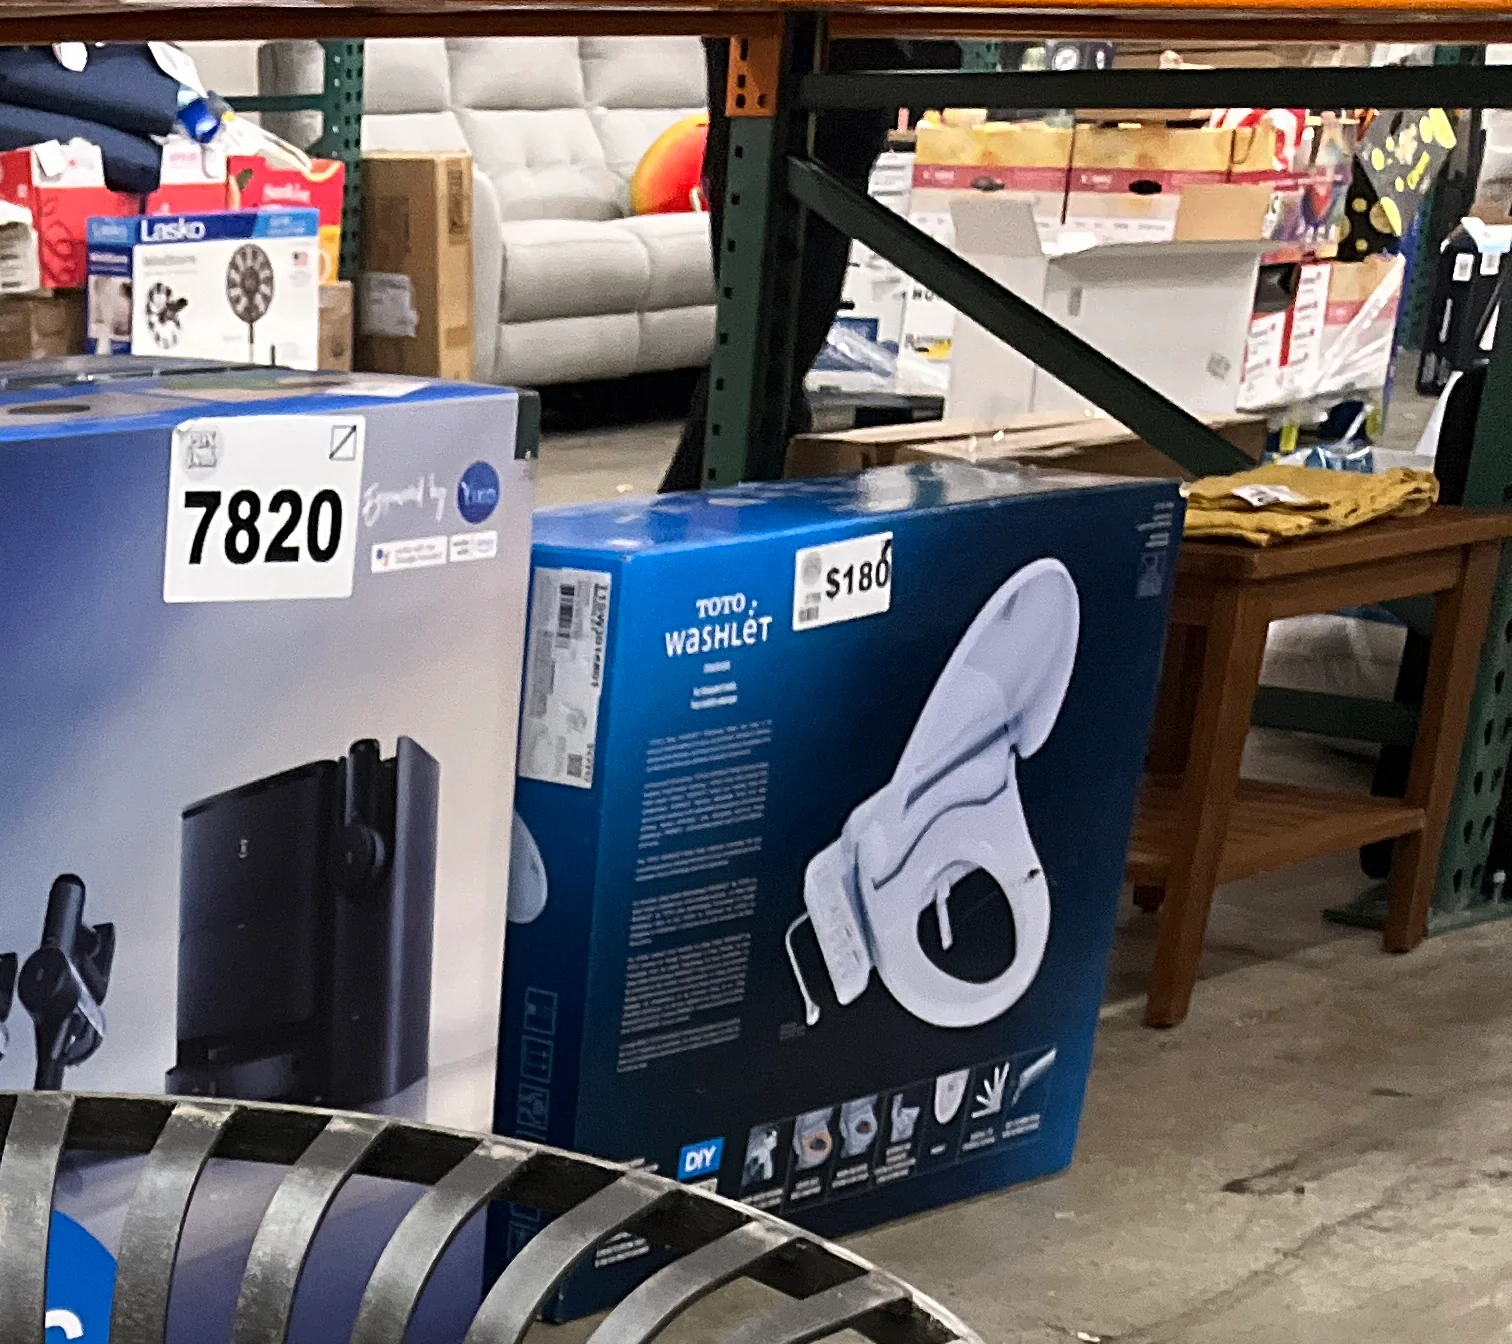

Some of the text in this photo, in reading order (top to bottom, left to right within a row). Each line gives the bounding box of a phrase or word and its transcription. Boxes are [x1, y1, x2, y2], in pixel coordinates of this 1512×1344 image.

[141, 216, 206, 243] Lasko
[183, 482, 344, 566] 7820
[825, 556, 891, 600] $180
[696, 592, 747, 620] TOTO
[684, 1145, 719, 1173] DIY
